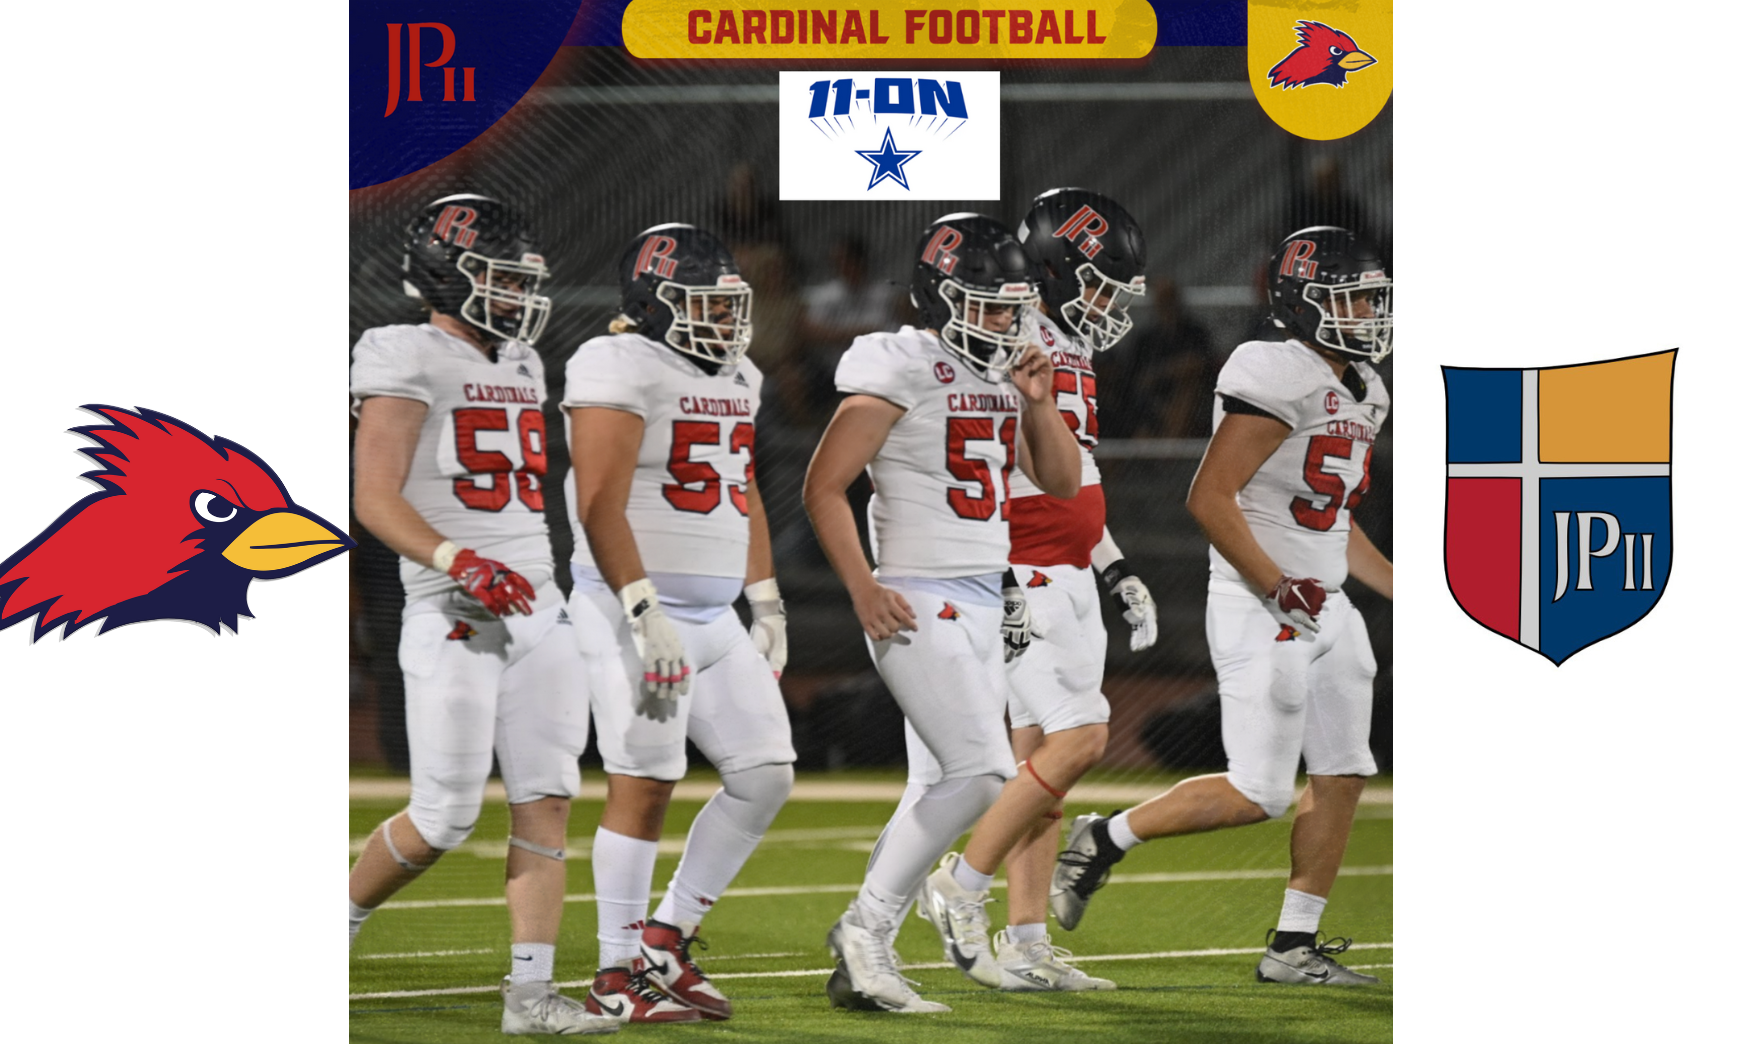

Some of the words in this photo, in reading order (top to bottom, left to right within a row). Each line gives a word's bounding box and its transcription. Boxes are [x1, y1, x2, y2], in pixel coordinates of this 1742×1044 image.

[935, 364, 953, 380] LC
[463, 383, 539, 404] CARDINALS
[1325, 396, 1340, 411] LC
[679, 396, 750, 417] CARDINALS
[453, 407, 548, 513] 58
[661, 419, 755, 516] 53
[946, 416, 1018, 522] 51
[1025, 971, 1051, 987] ALPHA
